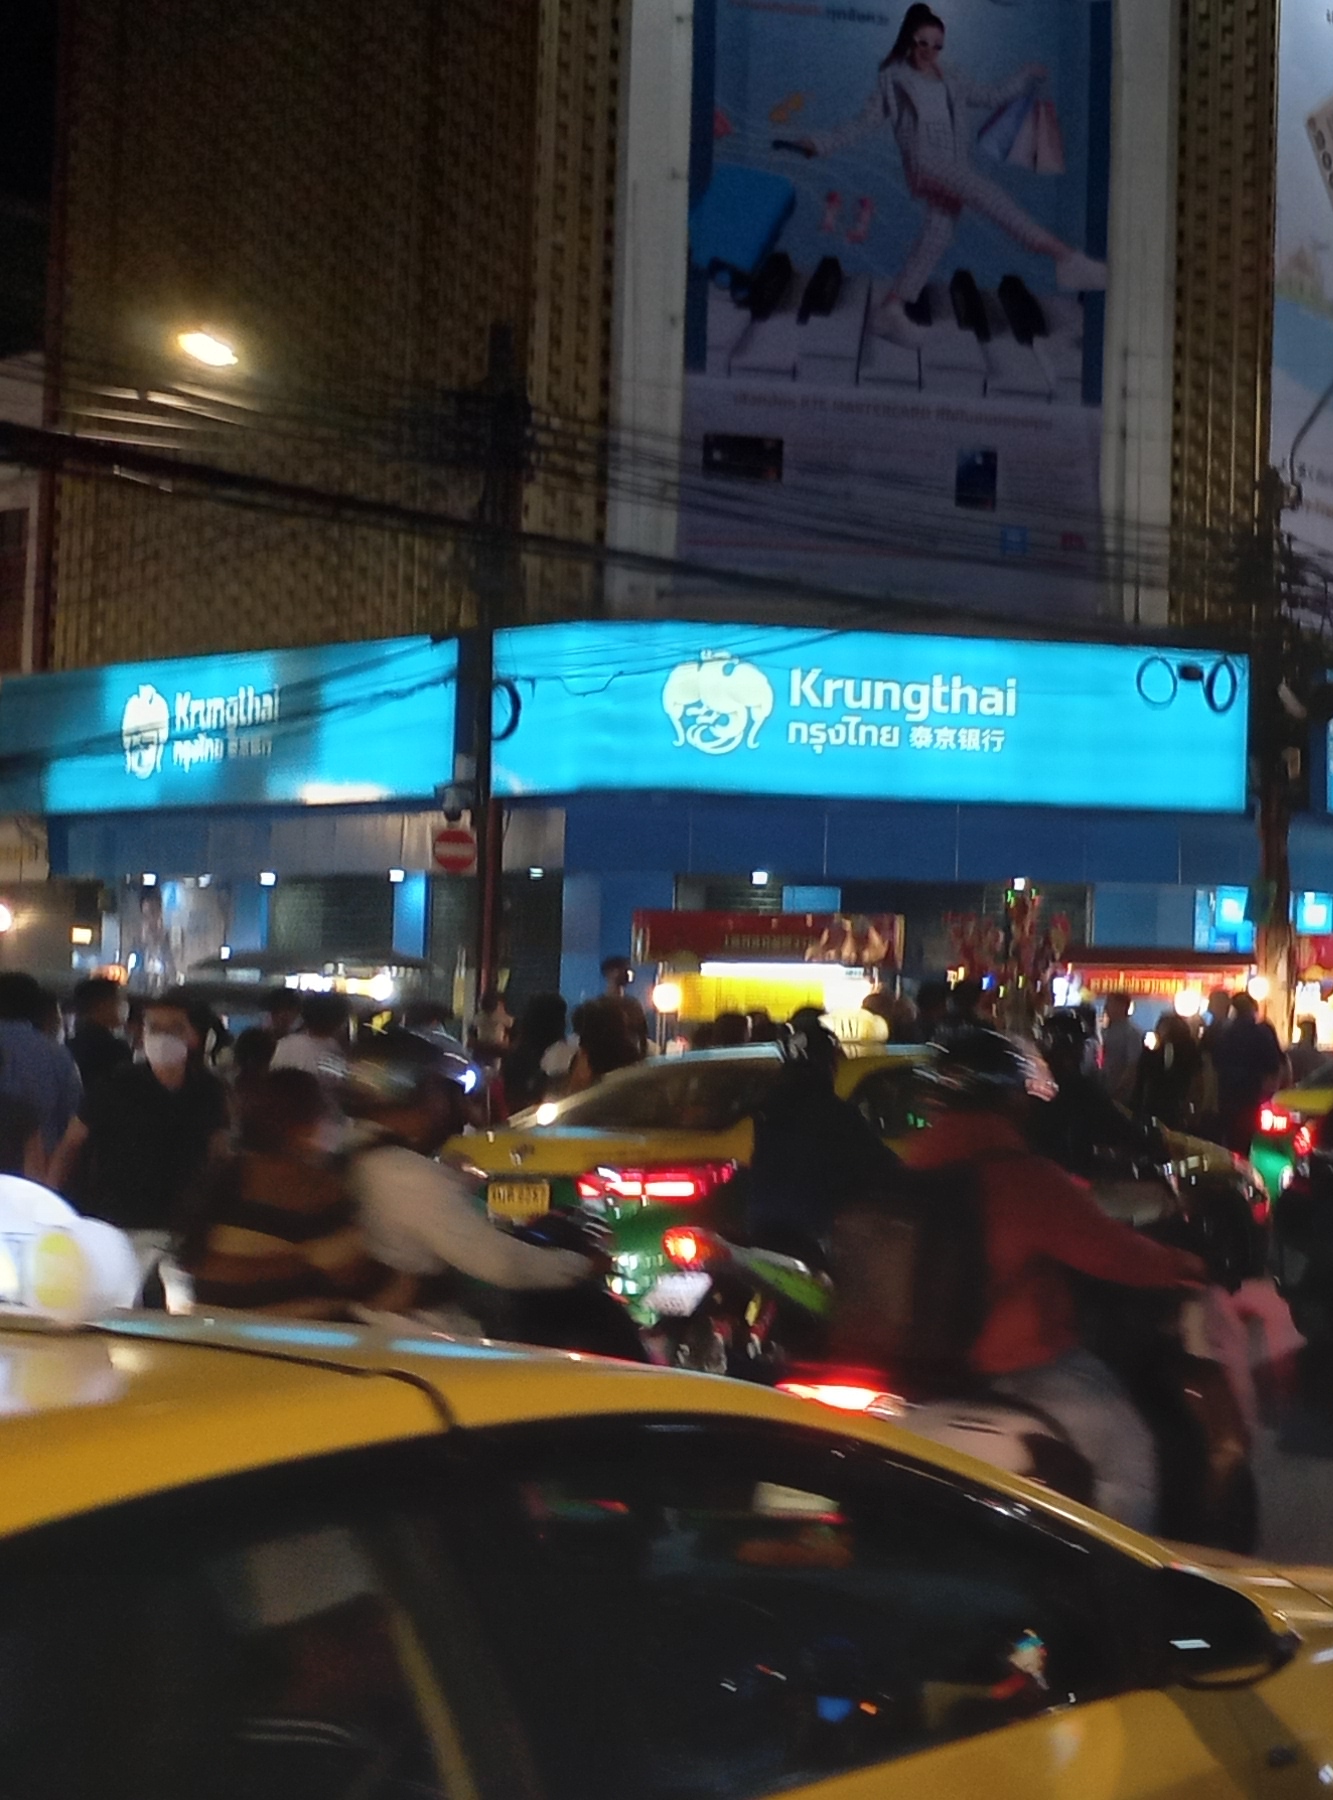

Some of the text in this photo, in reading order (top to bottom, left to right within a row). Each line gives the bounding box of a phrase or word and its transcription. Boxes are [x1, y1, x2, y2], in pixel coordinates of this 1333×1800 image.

[174, 683, 280, 735] Krungthai
[789, 666, 1017, 722] Krungthai
[788, 716, 1005, 755] กรุงไทย 泰京银行
